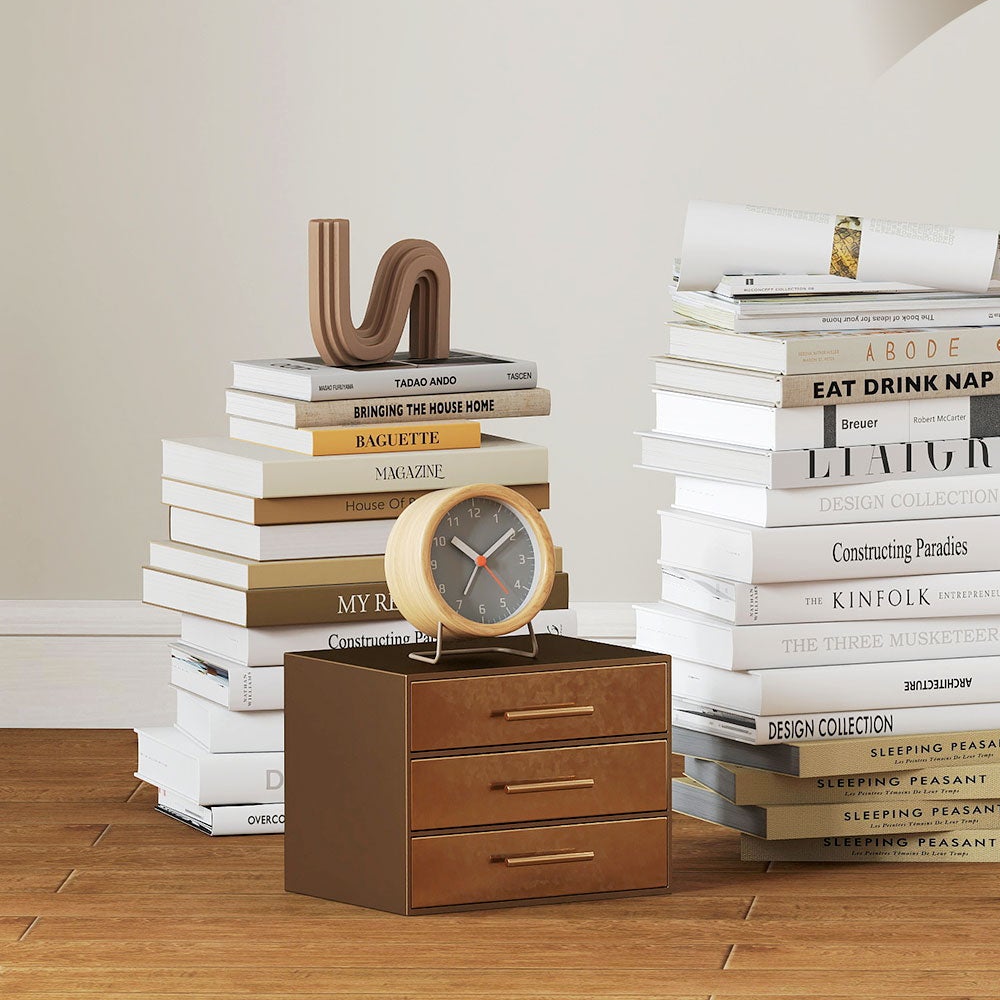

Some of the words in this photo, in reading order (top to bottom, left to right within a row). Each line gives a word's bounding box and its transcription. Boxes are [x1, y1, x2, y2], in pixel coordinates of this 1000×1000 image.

[866, 337, 960, 362] ABODE
[395, 377, 428, 388] TADAO
[429, 376, 457, 387] ANDO
[507, 372, 532, 381] TASCEN
[813, 380, 856, 399] EAT
[864, 374, 938, 396] DRINK
[945, 371, 994, 391] NAP
[354, 403, 404, 419] BRINGING
[406, 402, 427, 416] THE
[429, 401, 463, 415] HOUSE
[466, 400, 495, 413] HOME
[841, 418, 878, 430] Breuer
[913, 416, 936, 424] Robert
[937, 413, 967, 423] McCarter
[355, 431, 440, 448] BAGUETTE
[375, 464, 445, 481] MAGAZINE
[345, 500, 385, 512] House
[819, 495, 885, 512] DESIGN
[891, 488, 999, 508] COLLECTION
[469, 508, 481, 518] 12
[492, 514, 498, 524] 1
[448, 516, 460, 526] 11
[433, 536, 446, 546] 10
[832, 539, 912, 565] Constructing
[915, 535, 968, 559] Paradies
[431, 560, 438, 570] 9
[518, 554, 526, 564] 3
[439, 584, 446, 594] 8
[514, 580, 521, 590] 4
[337, 594, 371, 614] MY
[500, 598, 506, 608] 5
[804, 596, 823, 606] THE
[832, 588, 931, 609] KINFOLK
[456, 600, 462, 610] 7
[478, 604, 486, 614] 6
[328, 631, 411, 650] Constructing
[781, 638, 818, 653] THE
[823, 634, 884, 651] THREE
[903, 677, 973, 692] ARCHITECTURE
[768, 719, 815, 740] DESIGN
[818, 714, 894, 738] COLLECTION
[870, 743, 943, 758] SLEEPING
[816, 777, 901, 789] SLEEPING
[910, 774, 987, 786] PEASANT
[843, 808, 923, 822] SLEEPING
[823, 837, 908, 847] SLEEPING
[918, 838, 997, 848] PEASANT
